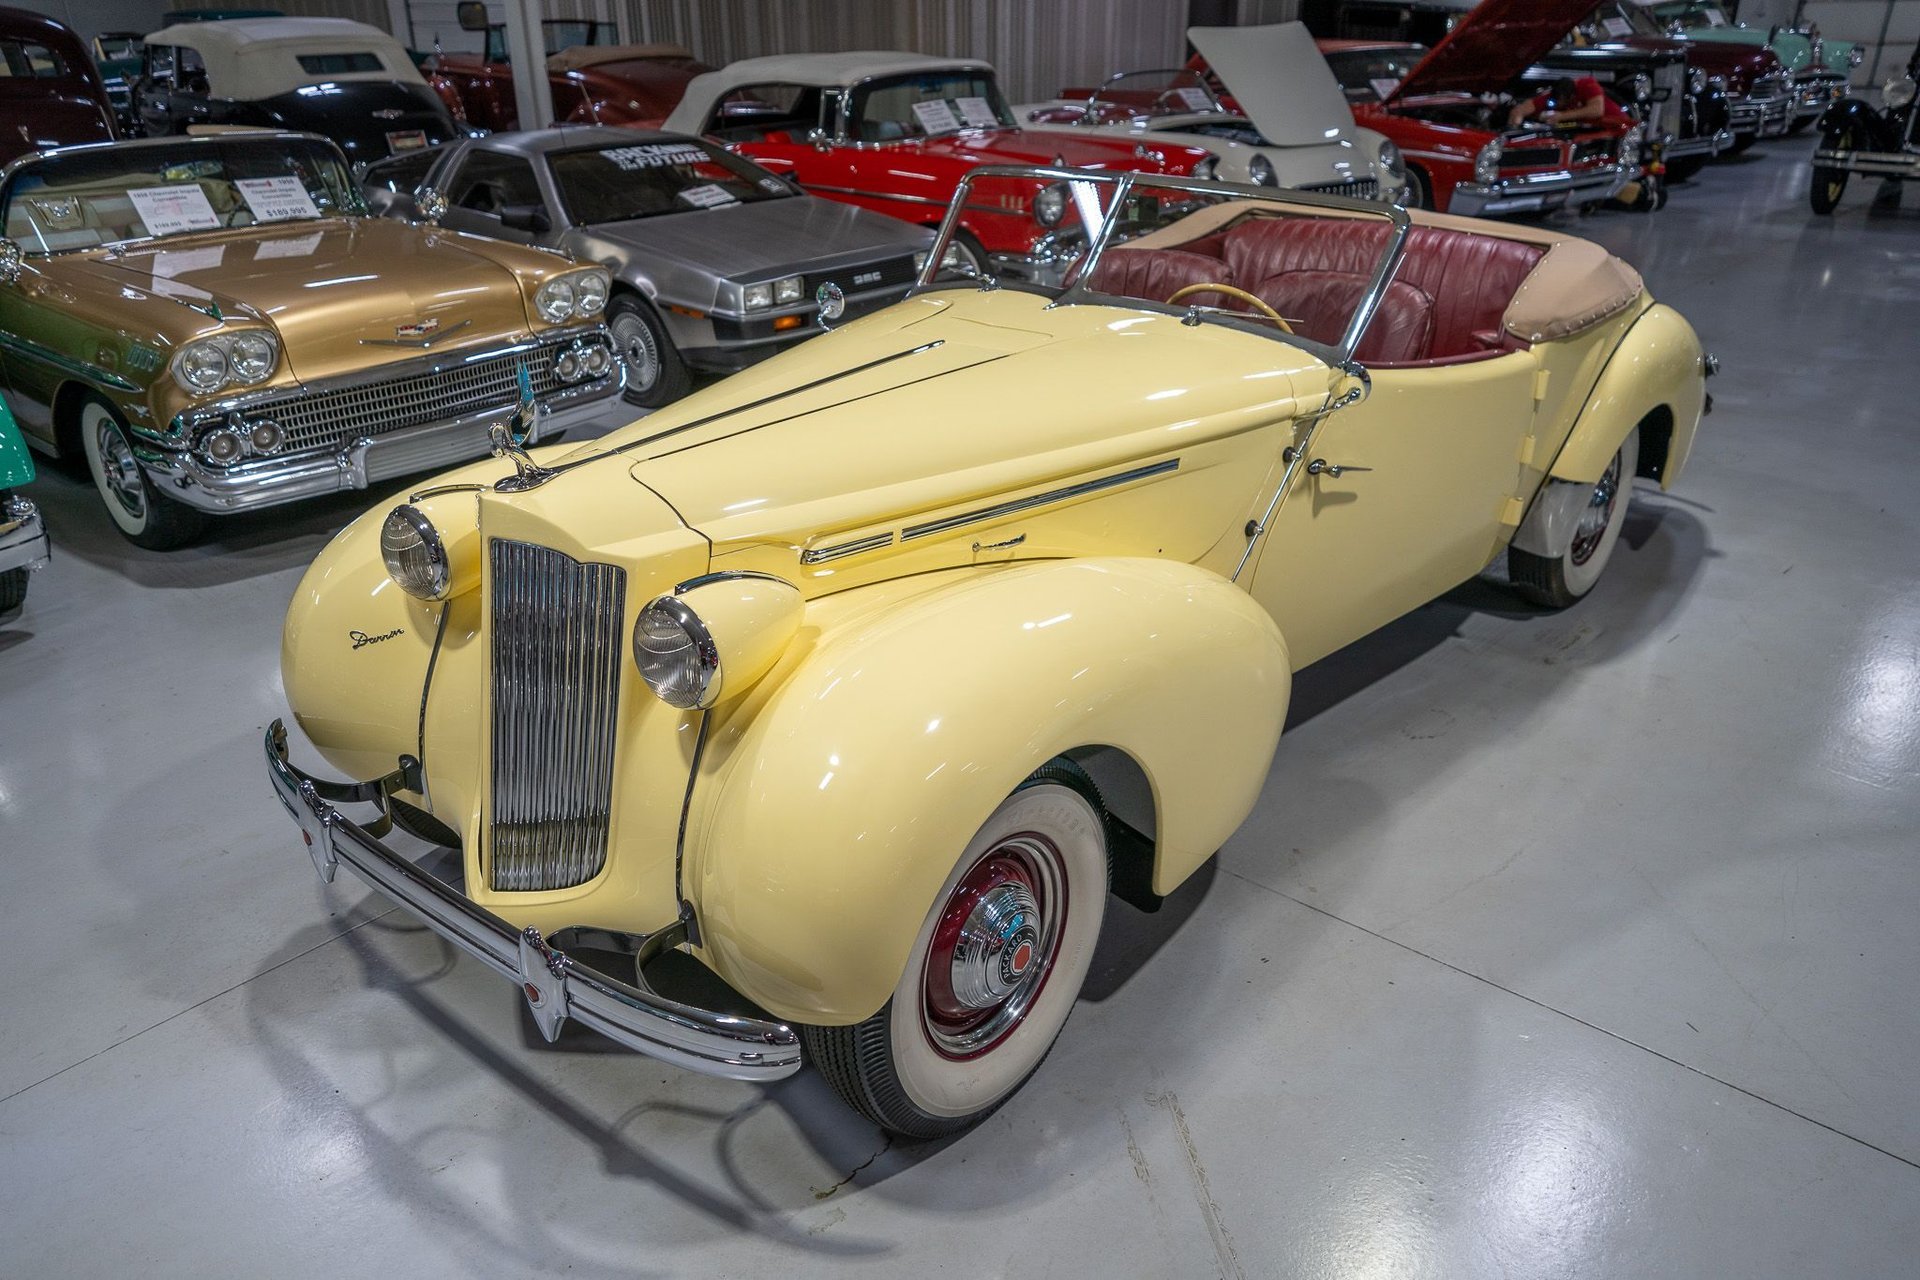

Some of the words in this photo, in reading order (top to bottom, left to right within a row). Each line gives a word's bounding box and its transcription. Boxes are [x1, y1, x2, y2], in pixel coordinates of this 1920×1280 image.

[634, 151, 711, 168] FUTURE
[349, 628, 405, 650] Darrin
[1002, 934, 1022, 979] PACKARD
